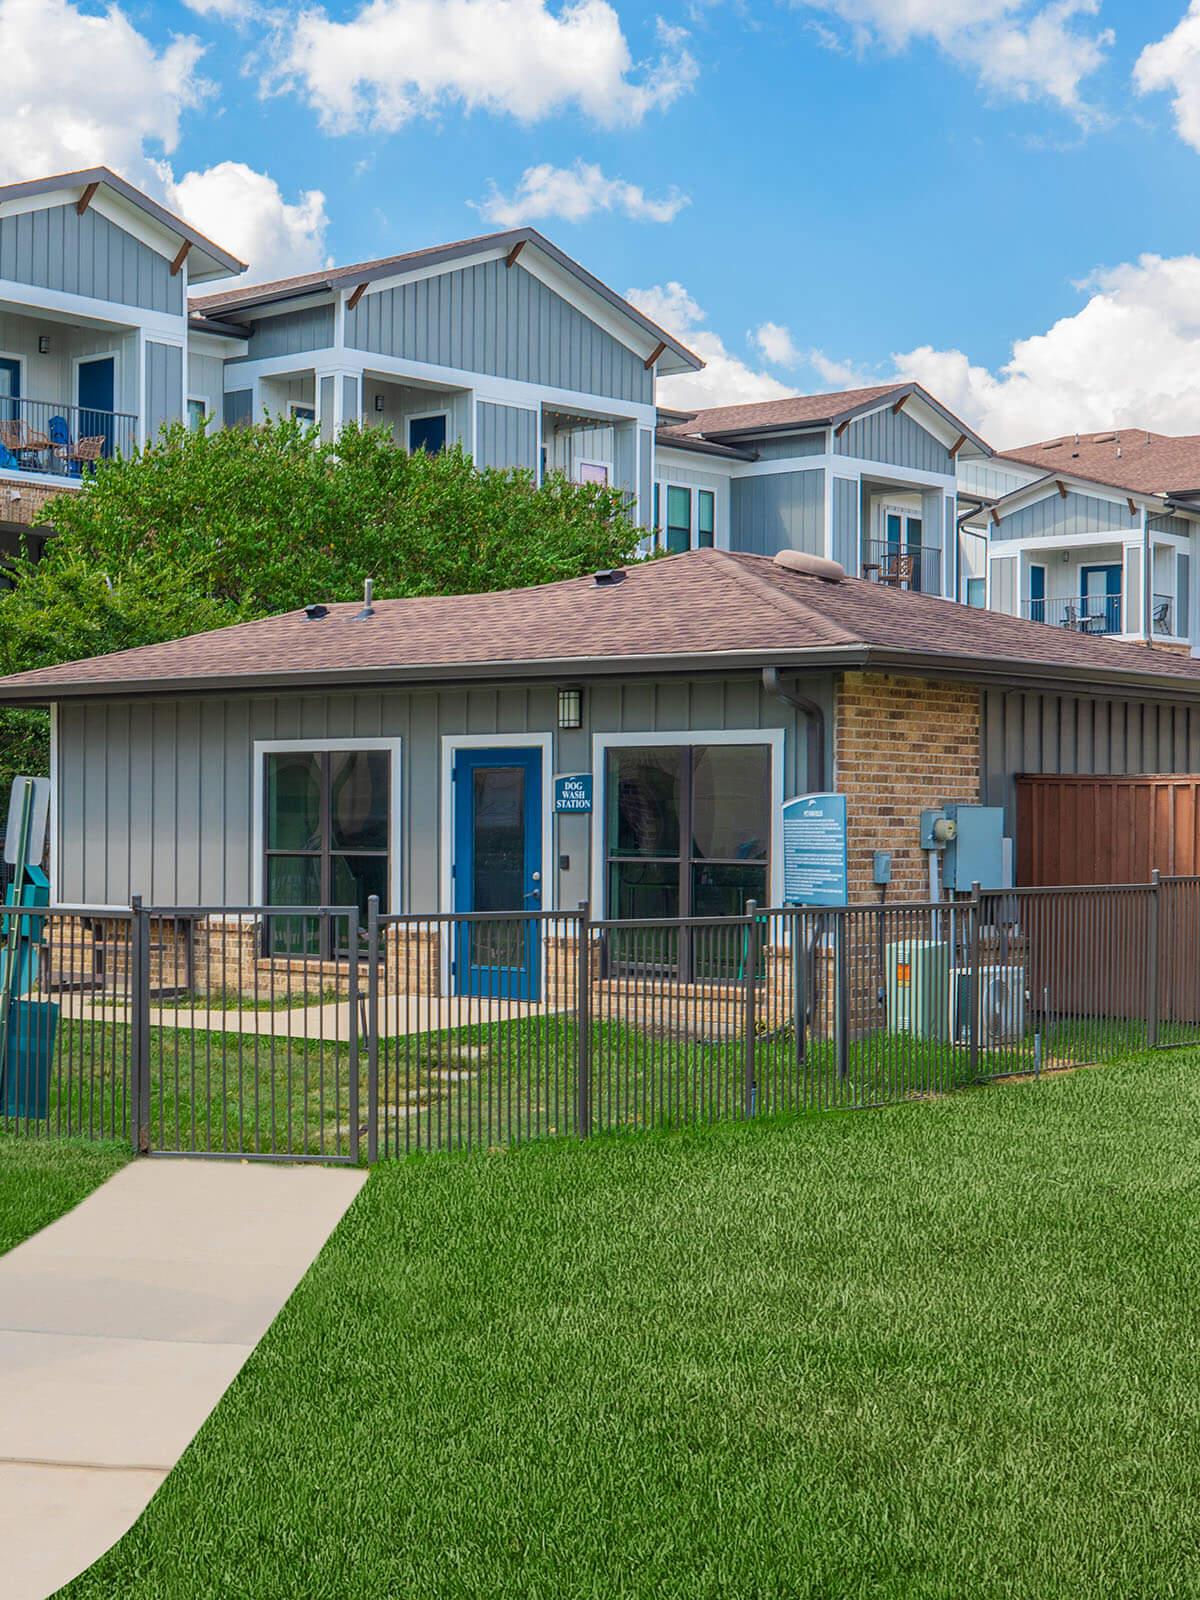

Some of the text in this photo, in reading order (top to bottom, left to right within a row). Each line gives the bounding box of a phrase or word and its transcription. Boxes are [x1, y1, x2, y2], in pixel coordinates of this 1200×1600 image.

[564, 782, 583, 790] DOG
[562, 791, 585, 799] WASH
[556, 800, 591, 808] STATION
